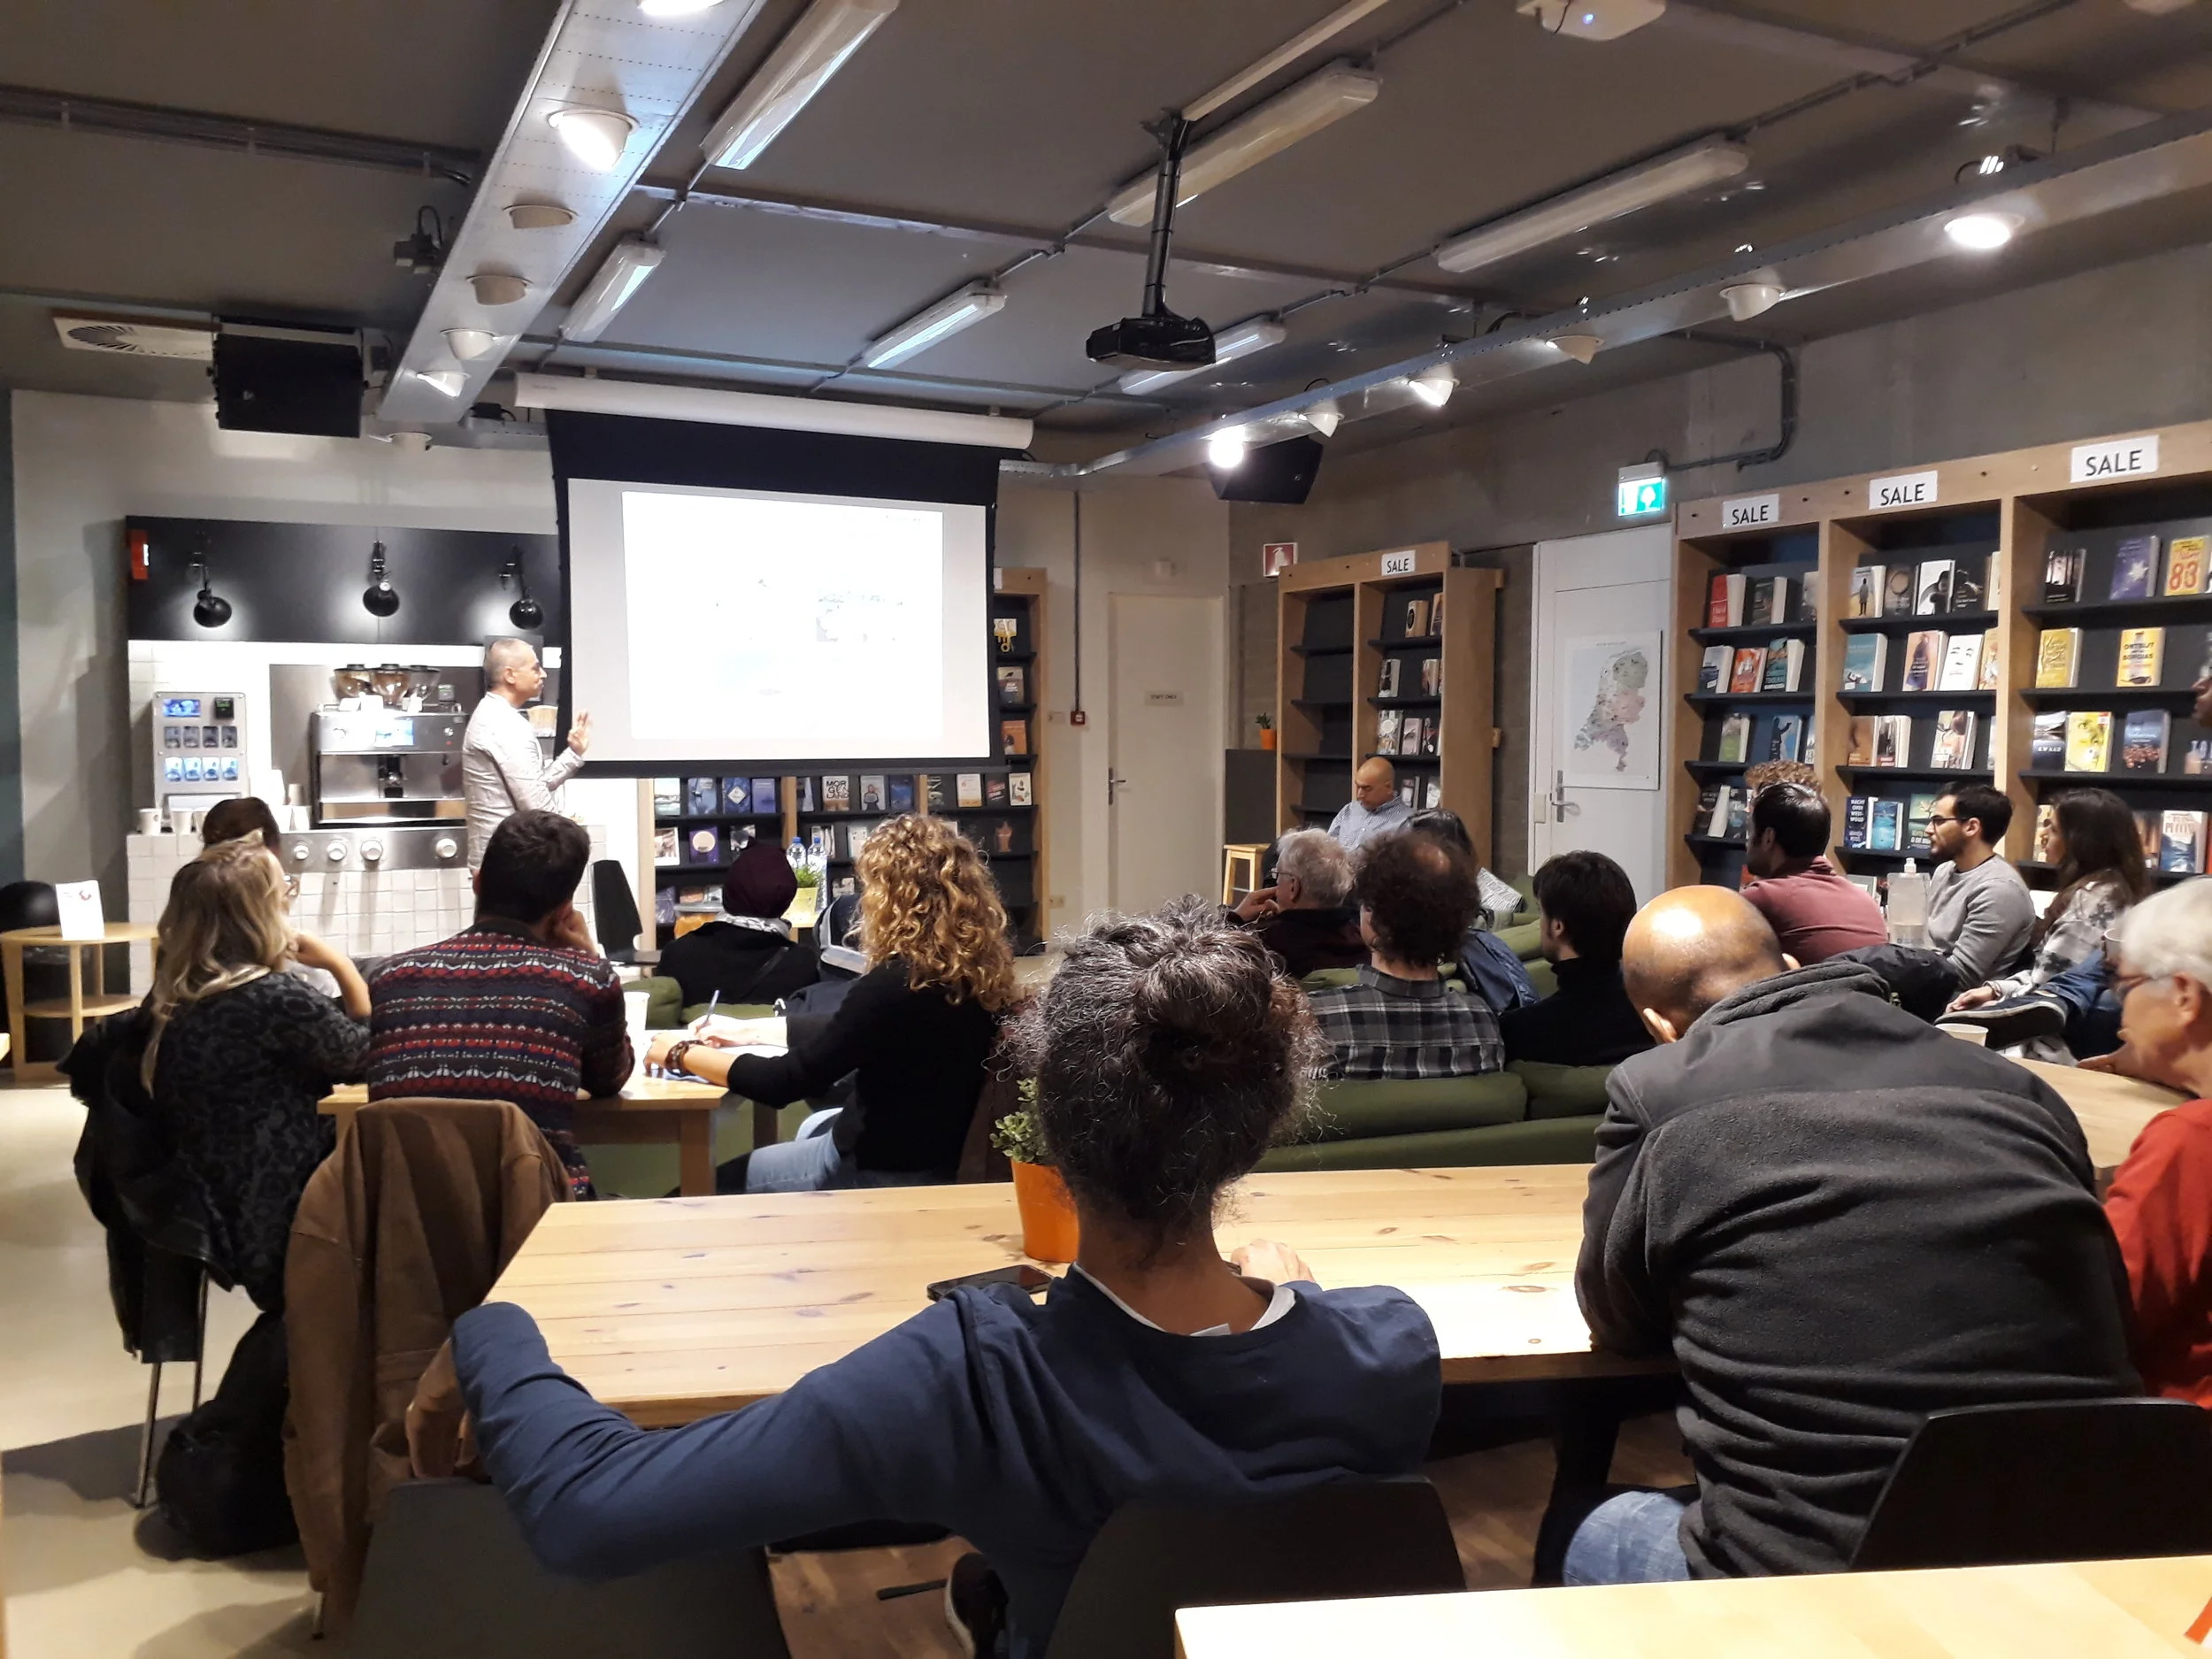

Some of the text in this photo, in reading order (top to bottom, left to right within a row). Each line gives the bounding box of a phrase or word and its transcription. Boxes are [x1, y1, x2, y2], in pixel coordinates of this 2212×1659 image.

[2085, 449, 2142, 476] SALE
[1880, 483, 1926, 506] SALE
[1732, 503, 1770, 526] SALE
[1386, 558, 1409, 573] SALE
[2169, 560, 2200, 591] 83
